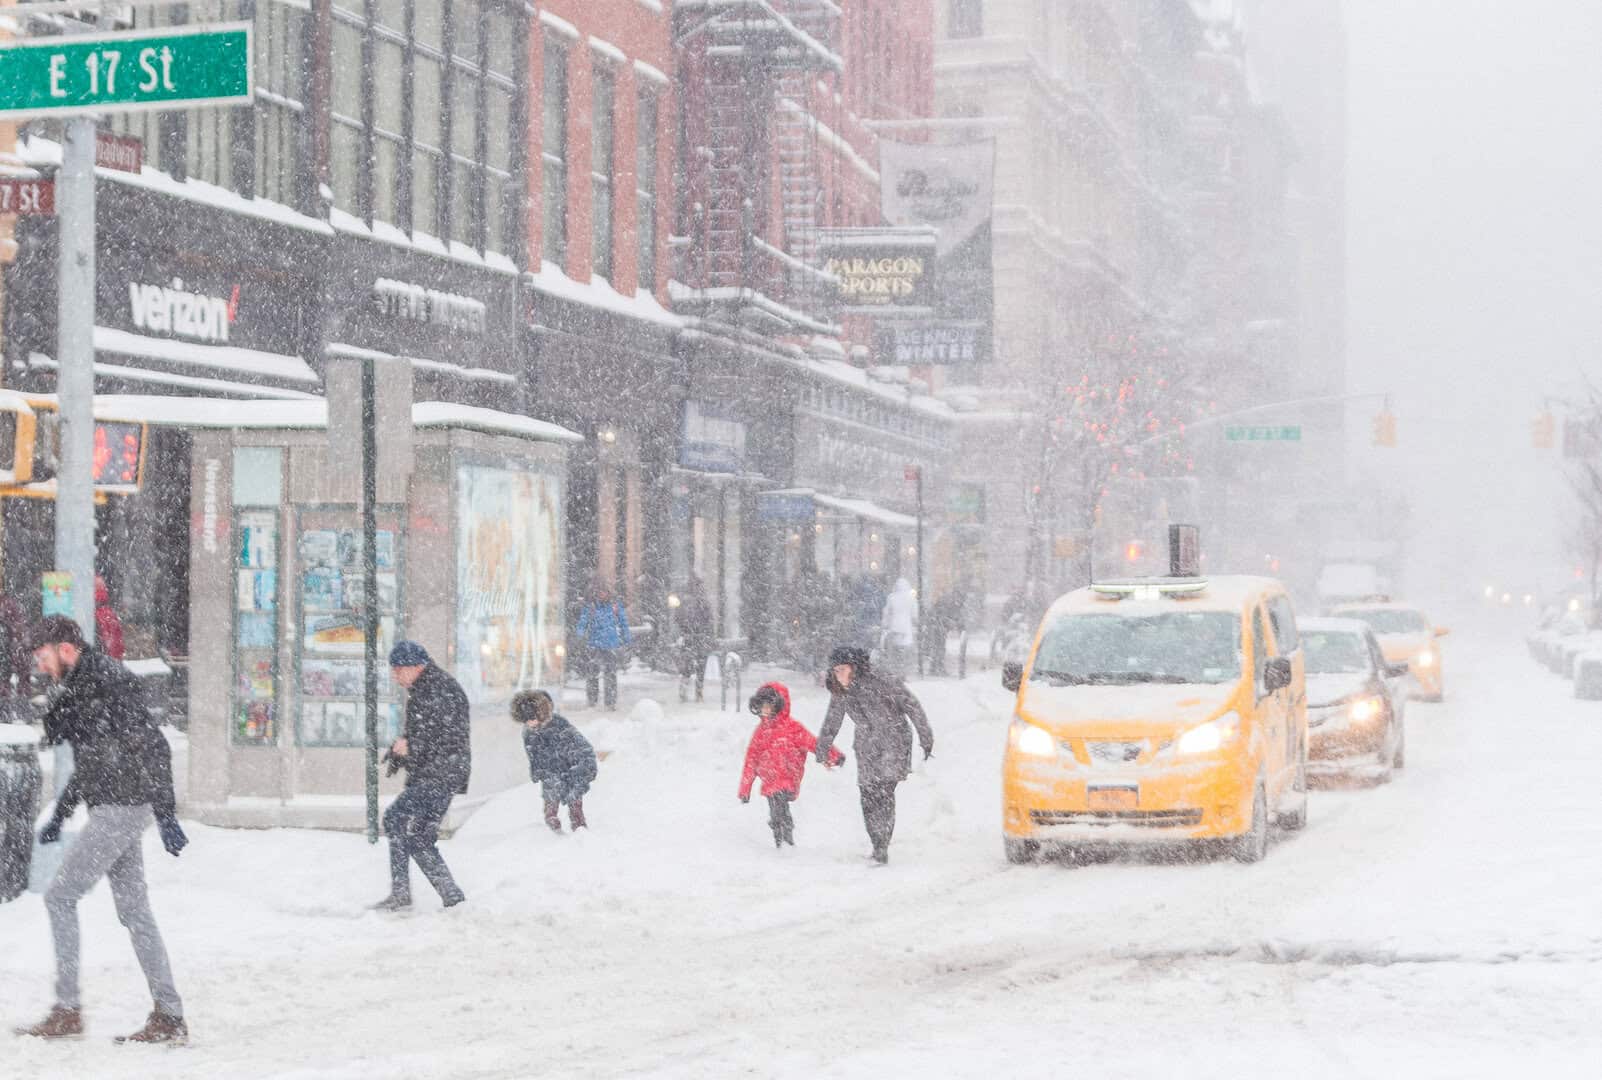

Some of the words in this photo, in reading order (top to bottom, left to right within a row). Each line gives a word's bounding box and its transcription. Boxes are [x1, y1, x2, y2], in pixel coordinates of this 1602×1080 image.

[49, 54, 68, 98] E
[86, 50, 121, 94] 17
[139, 45, 174, 92] St
[19, 183, 40, 211] St
[823, 256, 923, 275] PARAGON
[128, 276, 229, 340] verizon
[895, 344, 977, 361] WINTER
